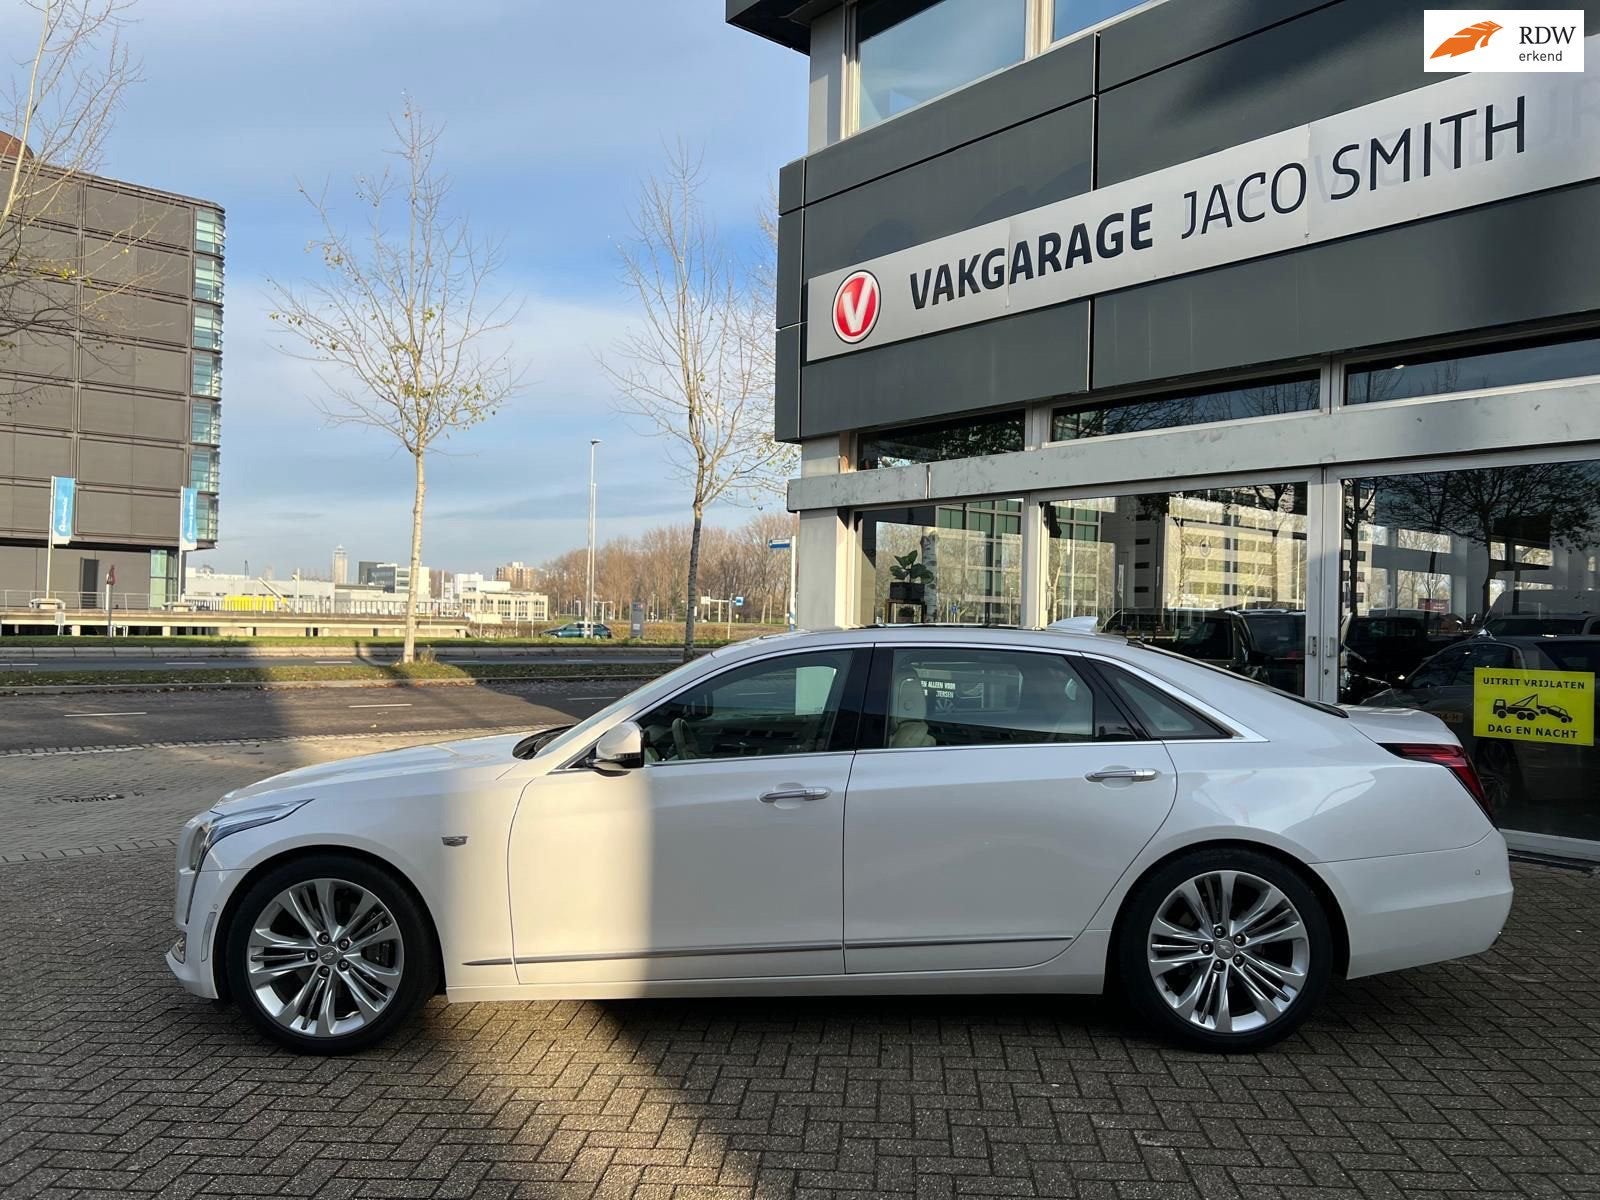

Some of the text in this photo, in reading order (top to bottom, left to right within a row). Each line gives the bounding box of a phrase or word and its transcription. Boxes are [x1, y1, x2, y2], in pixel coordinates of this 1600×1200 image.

[909, 203, 1153, 310] VAKGARAGE
[1181, 162, 1307, 240] JACO
[1330, 95, 1525, 201] SMITH
[1483, 677, 1585, 690] UITRIT VRIJLATEN
[1488, 724, 1578, 738] DAG EN NACHT
